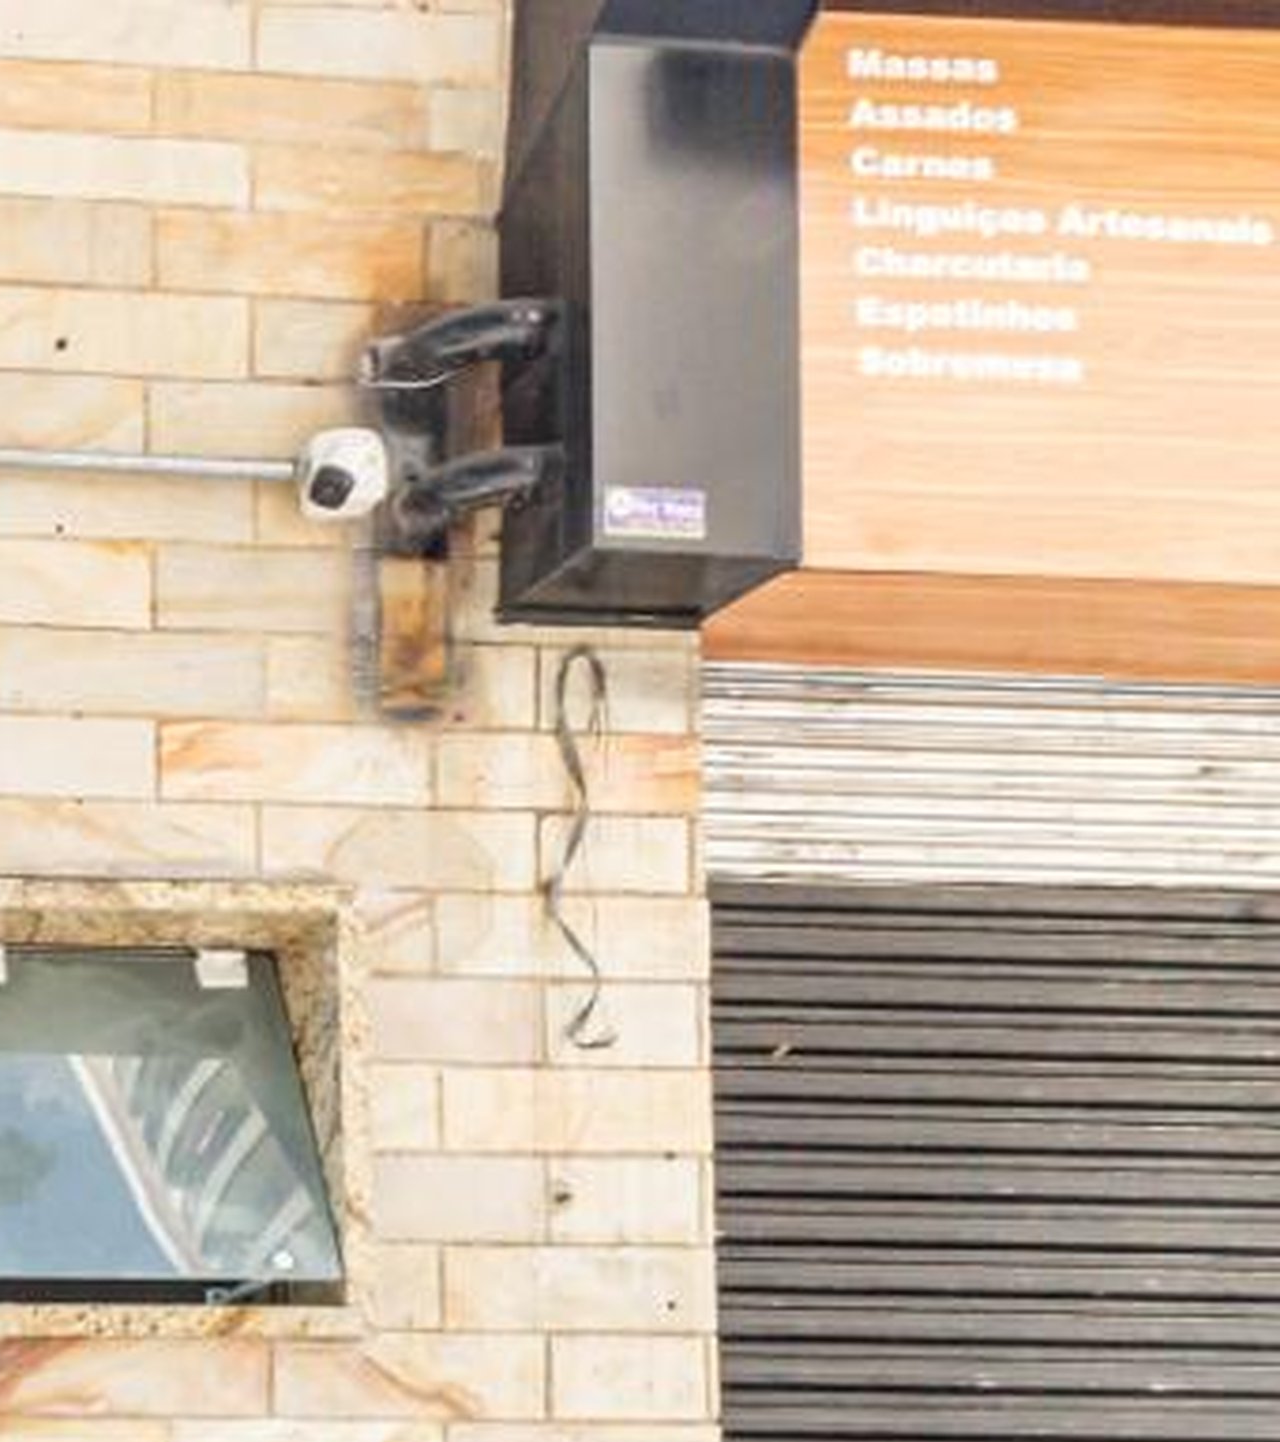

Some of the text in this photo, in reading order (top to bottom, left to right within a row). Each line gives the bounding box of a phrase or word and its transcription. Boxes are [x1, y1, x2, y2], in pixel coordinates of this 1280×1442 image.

[847, 48, 998, 83] Massas
[849, 99, 1017, 134] Assados
[851, 147, 995, 181] Carnes
